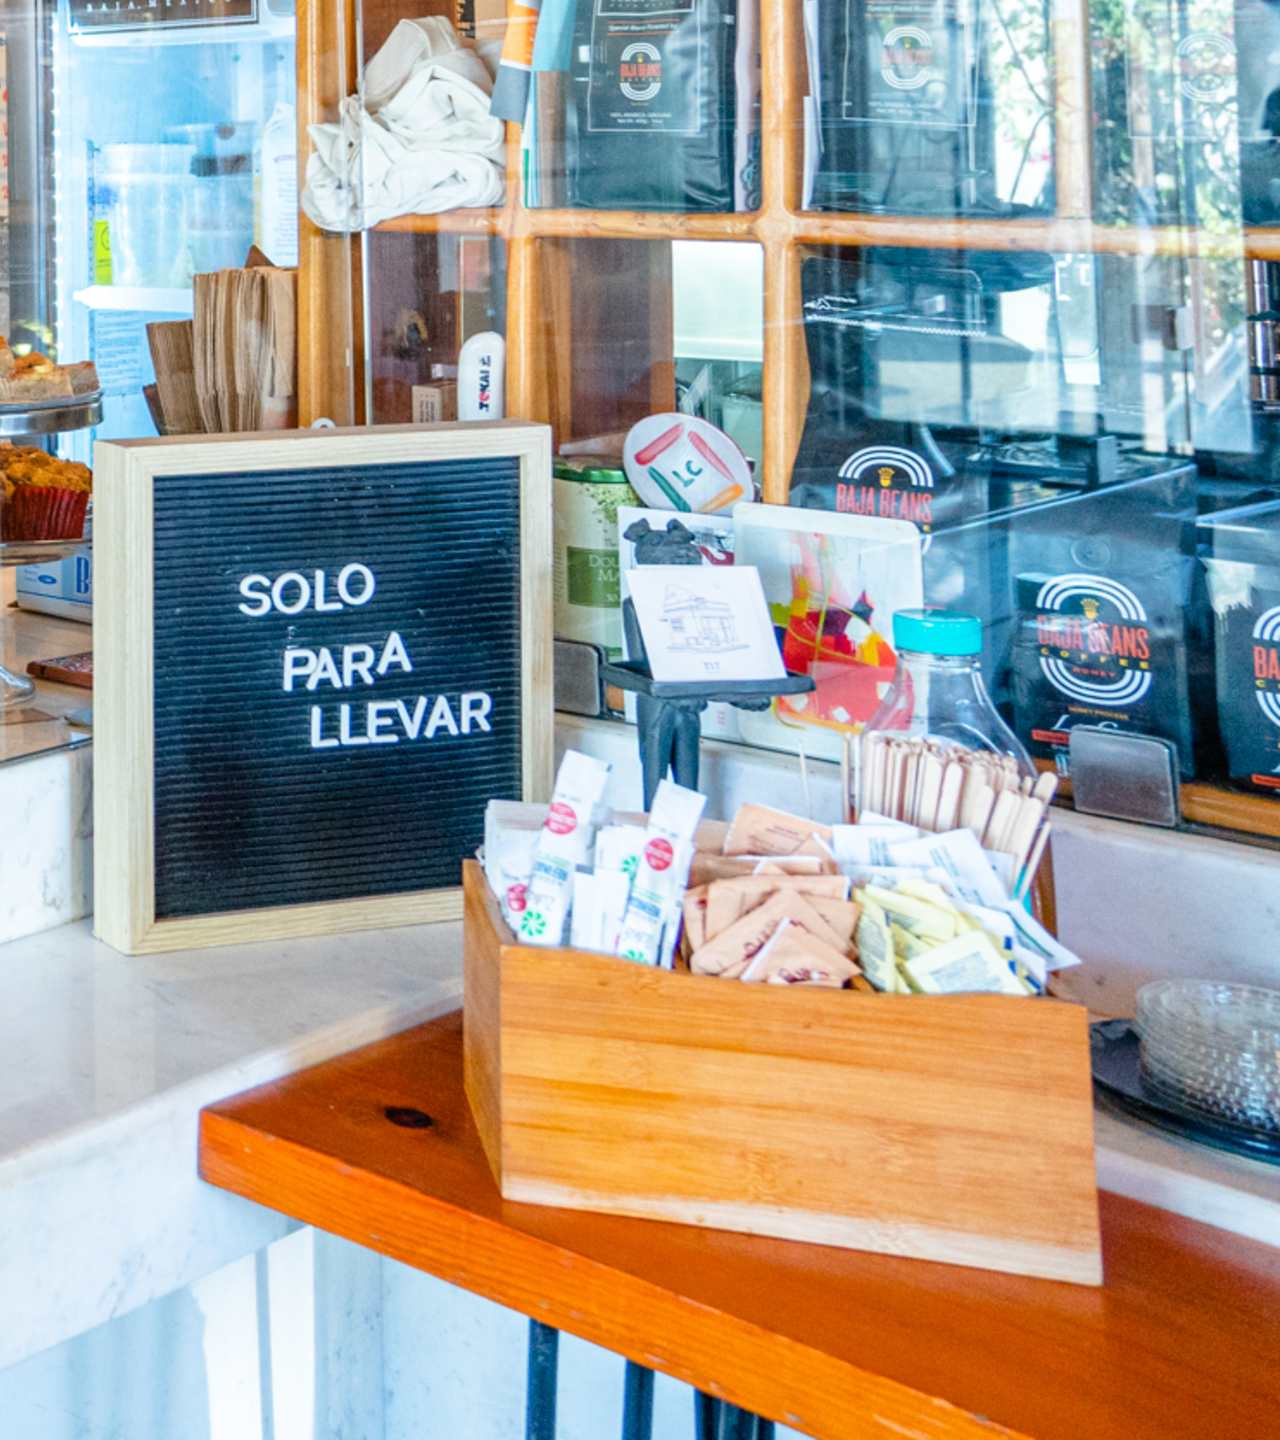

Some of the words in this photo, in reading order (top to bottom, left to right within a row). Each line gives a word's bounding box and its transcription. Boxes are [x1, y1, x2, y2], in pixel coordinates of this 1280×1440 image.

[836, 483, 875, 515] BAJA
[880, 489, 933, 524] BEANS
[238, 563, 375, 617] SOLO
[283, 631, 414, 692] PARA
[1036, 614, 1083, 650] BAJA
[1088, 621, 1150, 660] BEANS
[1041, 646, 1150, 670] COFFEE
[310, 692, 492, 749] LLEVAR
